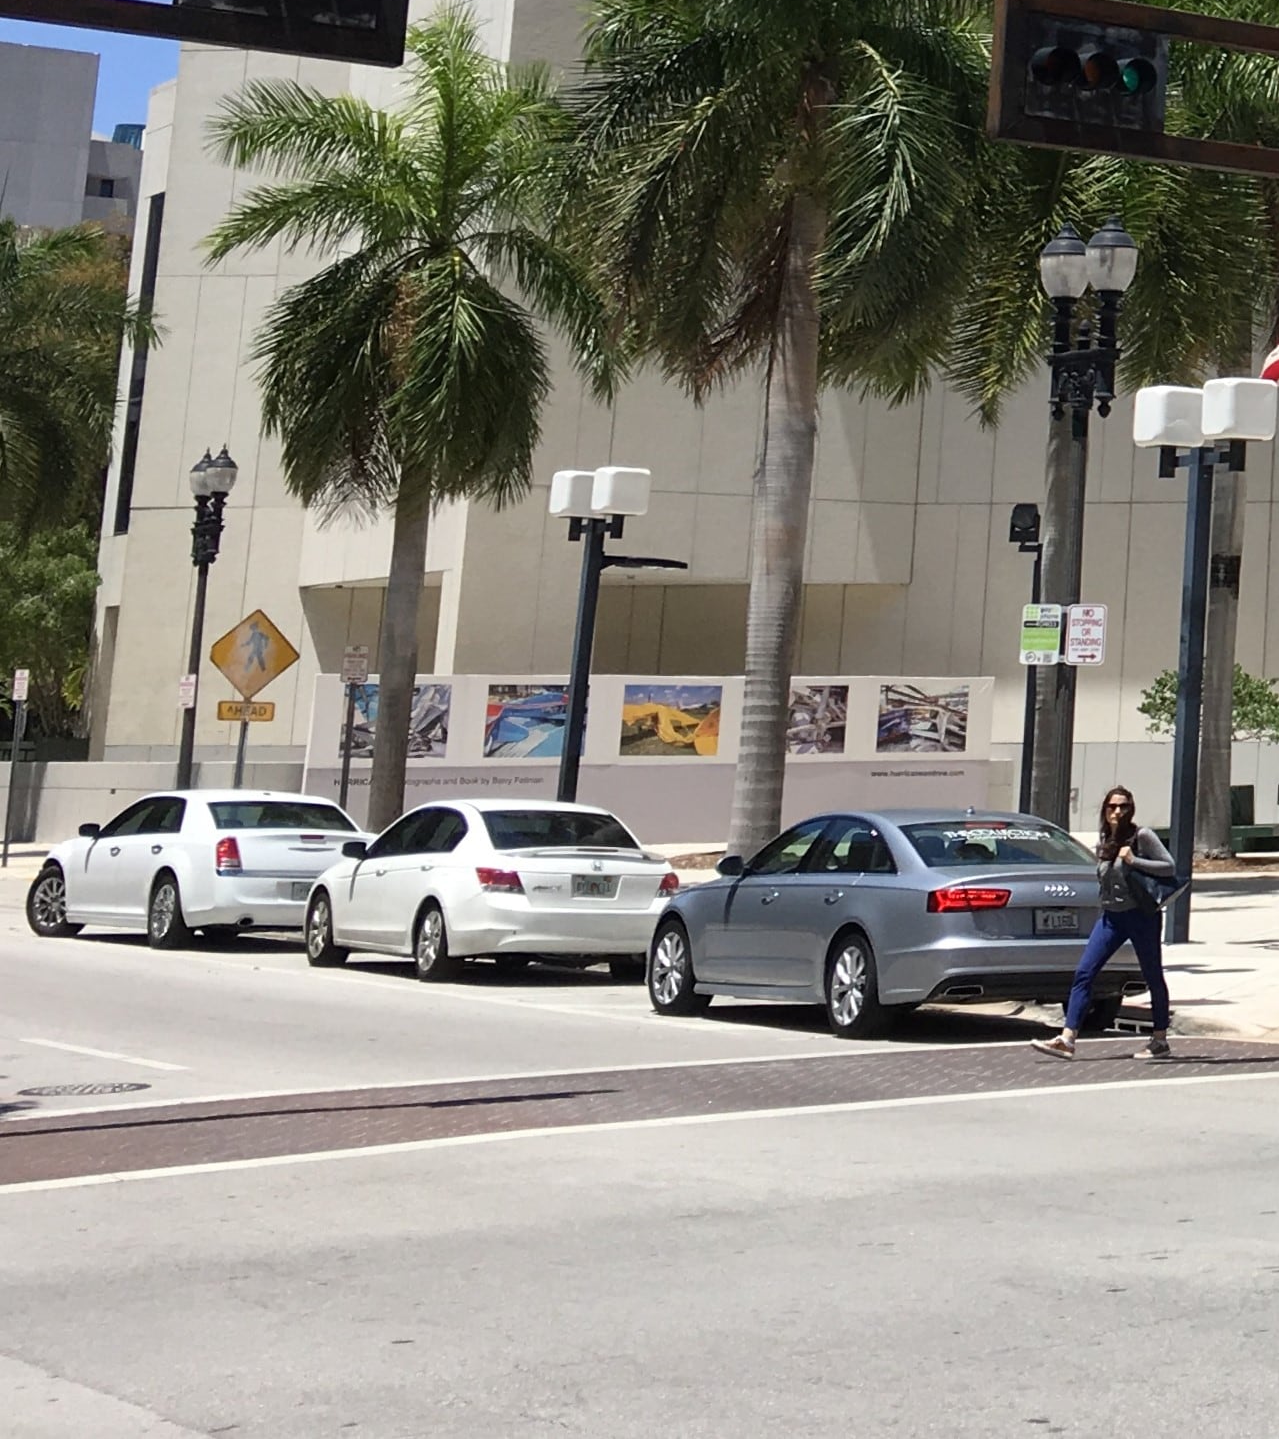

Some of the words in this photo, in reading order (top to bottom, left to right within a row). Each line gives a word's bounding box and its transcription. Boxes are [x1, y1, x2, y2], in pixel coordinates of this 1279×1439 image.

[1082, 608, 1095, 618] NO
[1071, 618, 1103, 627] STOPPING
[1081, 627, 1092, 636] OR
[1070, 637, 1102, 647] STANDING
